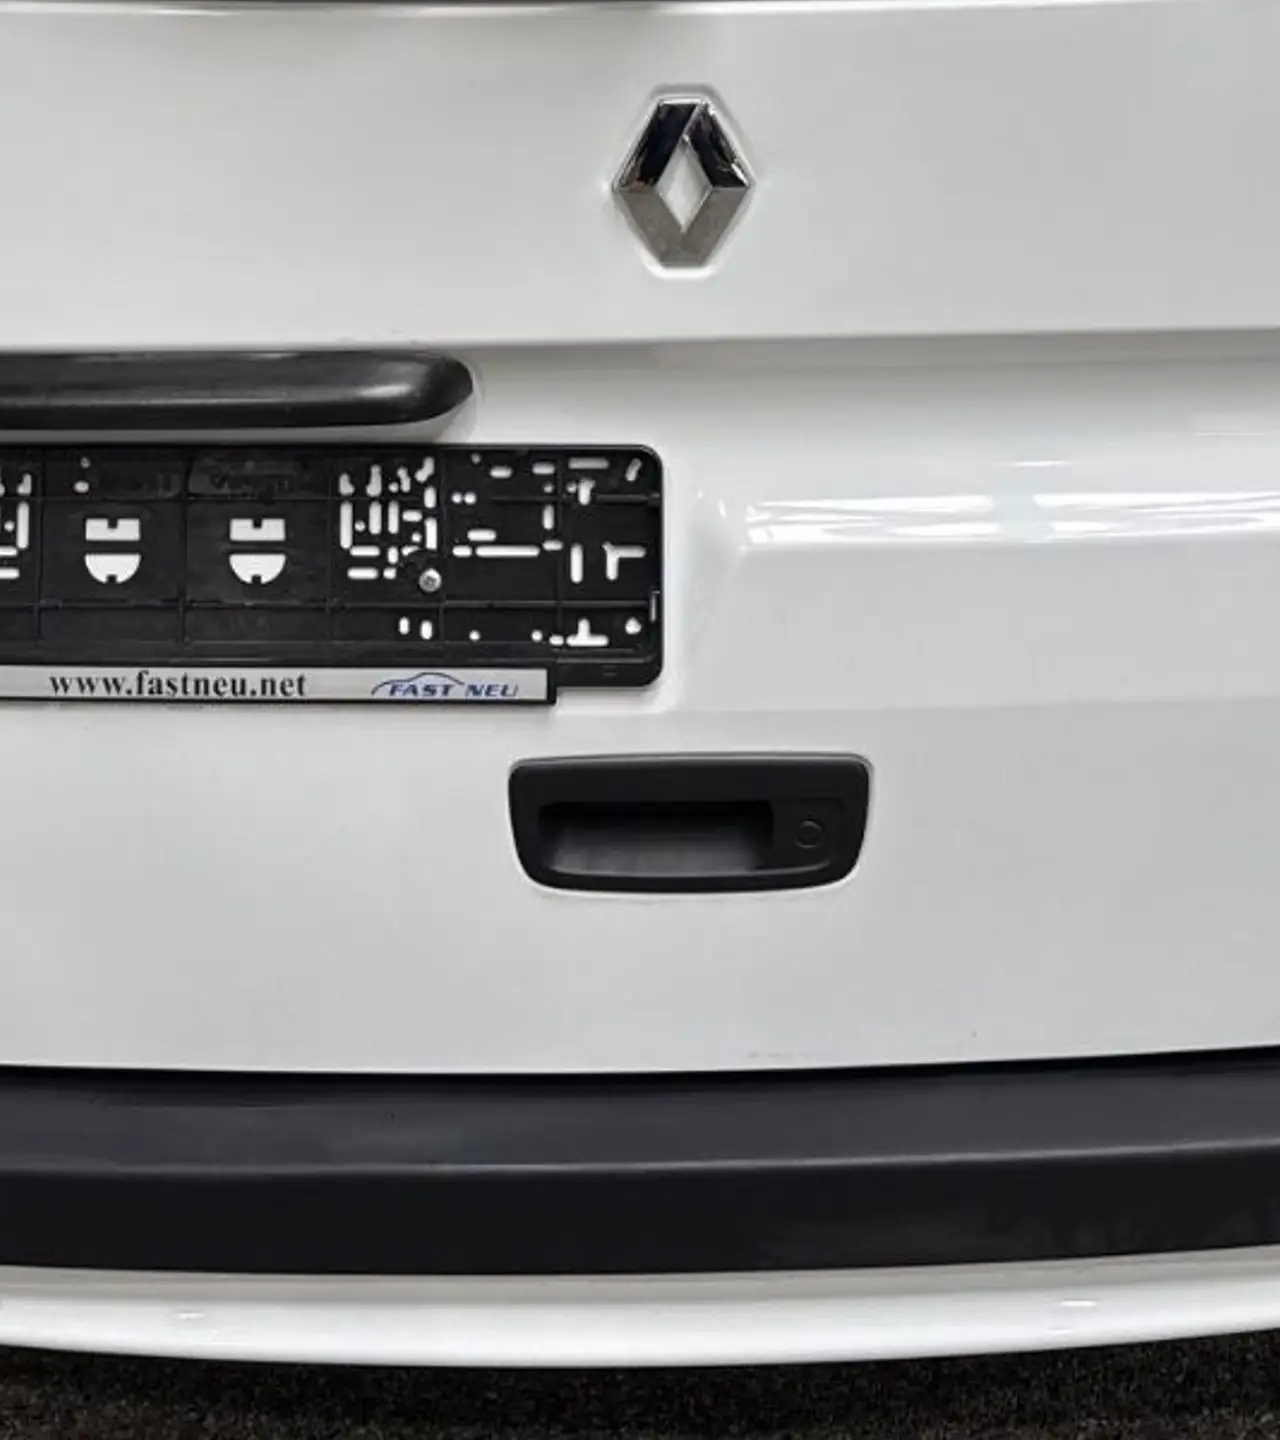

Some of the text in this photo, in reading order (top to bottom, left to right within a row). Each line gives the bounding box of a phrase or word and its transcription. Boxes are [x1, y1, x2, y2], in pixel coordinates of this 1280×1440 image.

[48, 669, 309, 698] www.fastneu.net
[388, 683, 519, 698] FAST NEU
